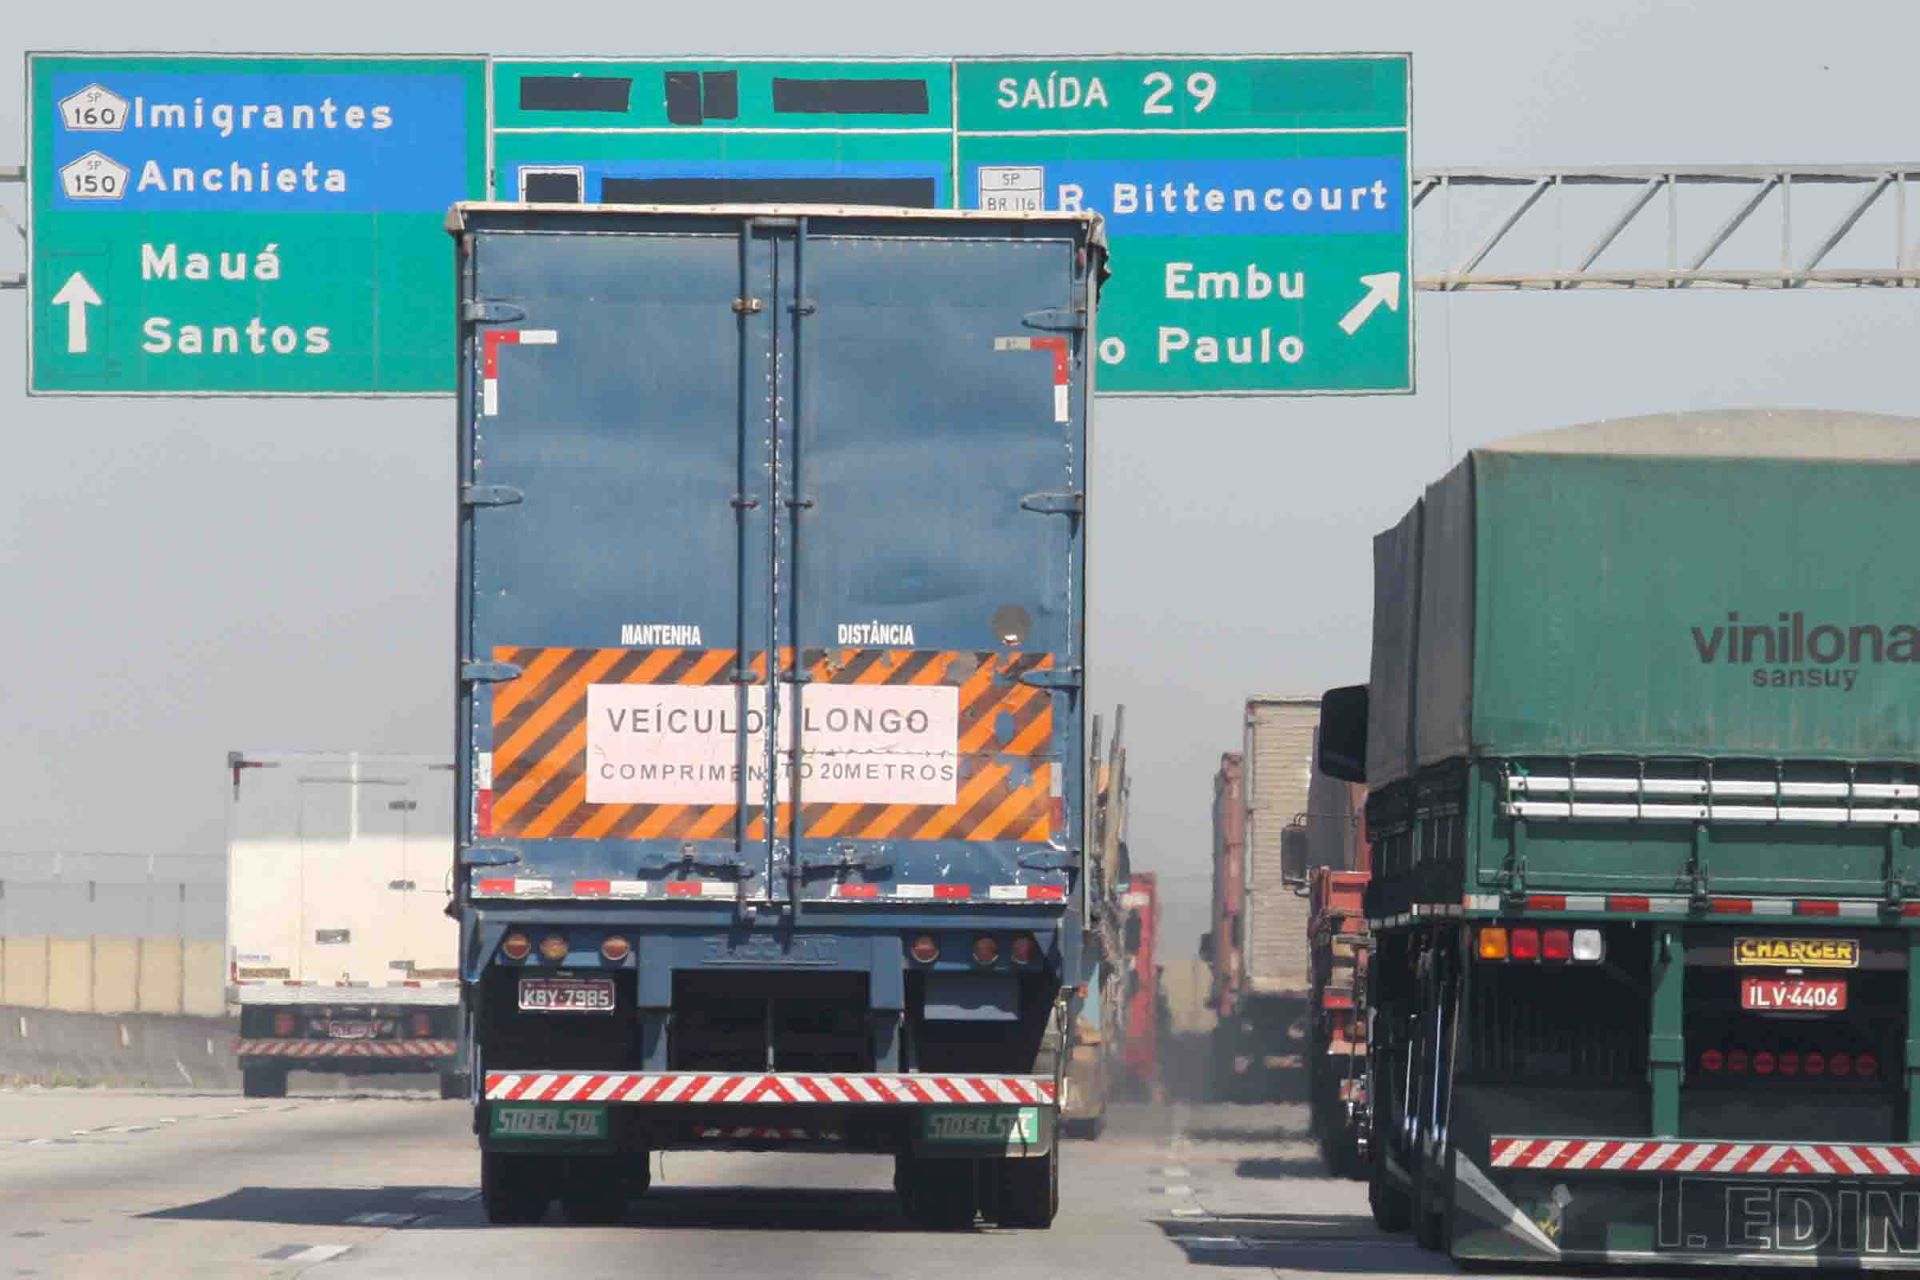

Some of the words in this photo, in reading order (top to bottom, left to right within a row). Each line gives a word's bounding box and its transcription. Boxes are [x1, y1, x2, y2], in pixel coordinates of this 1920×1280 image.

[87, 92, 102, 103] SP
[997, 71, 1109, 109] SAÍDA
[1143, 72, 1217, 115] 29
[75, 107, 116, 125] 160
[134, 96, 394, 138] Imigrantes
[87, 160, 102, 171] SP
[137, 160, 348, 193] Anchieta
[1002, 173, 1021, 186] SP
[75, 174, 116, 193] 150
[1113, 180, 1388, 215] Bittencourt
[987, 197, 1008, 211] BR
[1015, 197, 1036, 211] 116
[142, 243, 282, 281] Mauá
[1165, 263, 1306, 300] Embu
[142, 316, 331, 354] Santos
[1158, 327, 1305, 365] Paulo
[621, 624, 701, 645] MANTENHA
[837, 620, 914, 645] DISTÂNCIA
[1691, 611, 1920, 665] vinilona
[1752, 667, 1858, 692] sansuy
[606, 702, 764, 734] VEÍCULO
[804, 707, 929, 734] LONGO
[1741, 940, 1852, 959] CHARGER
